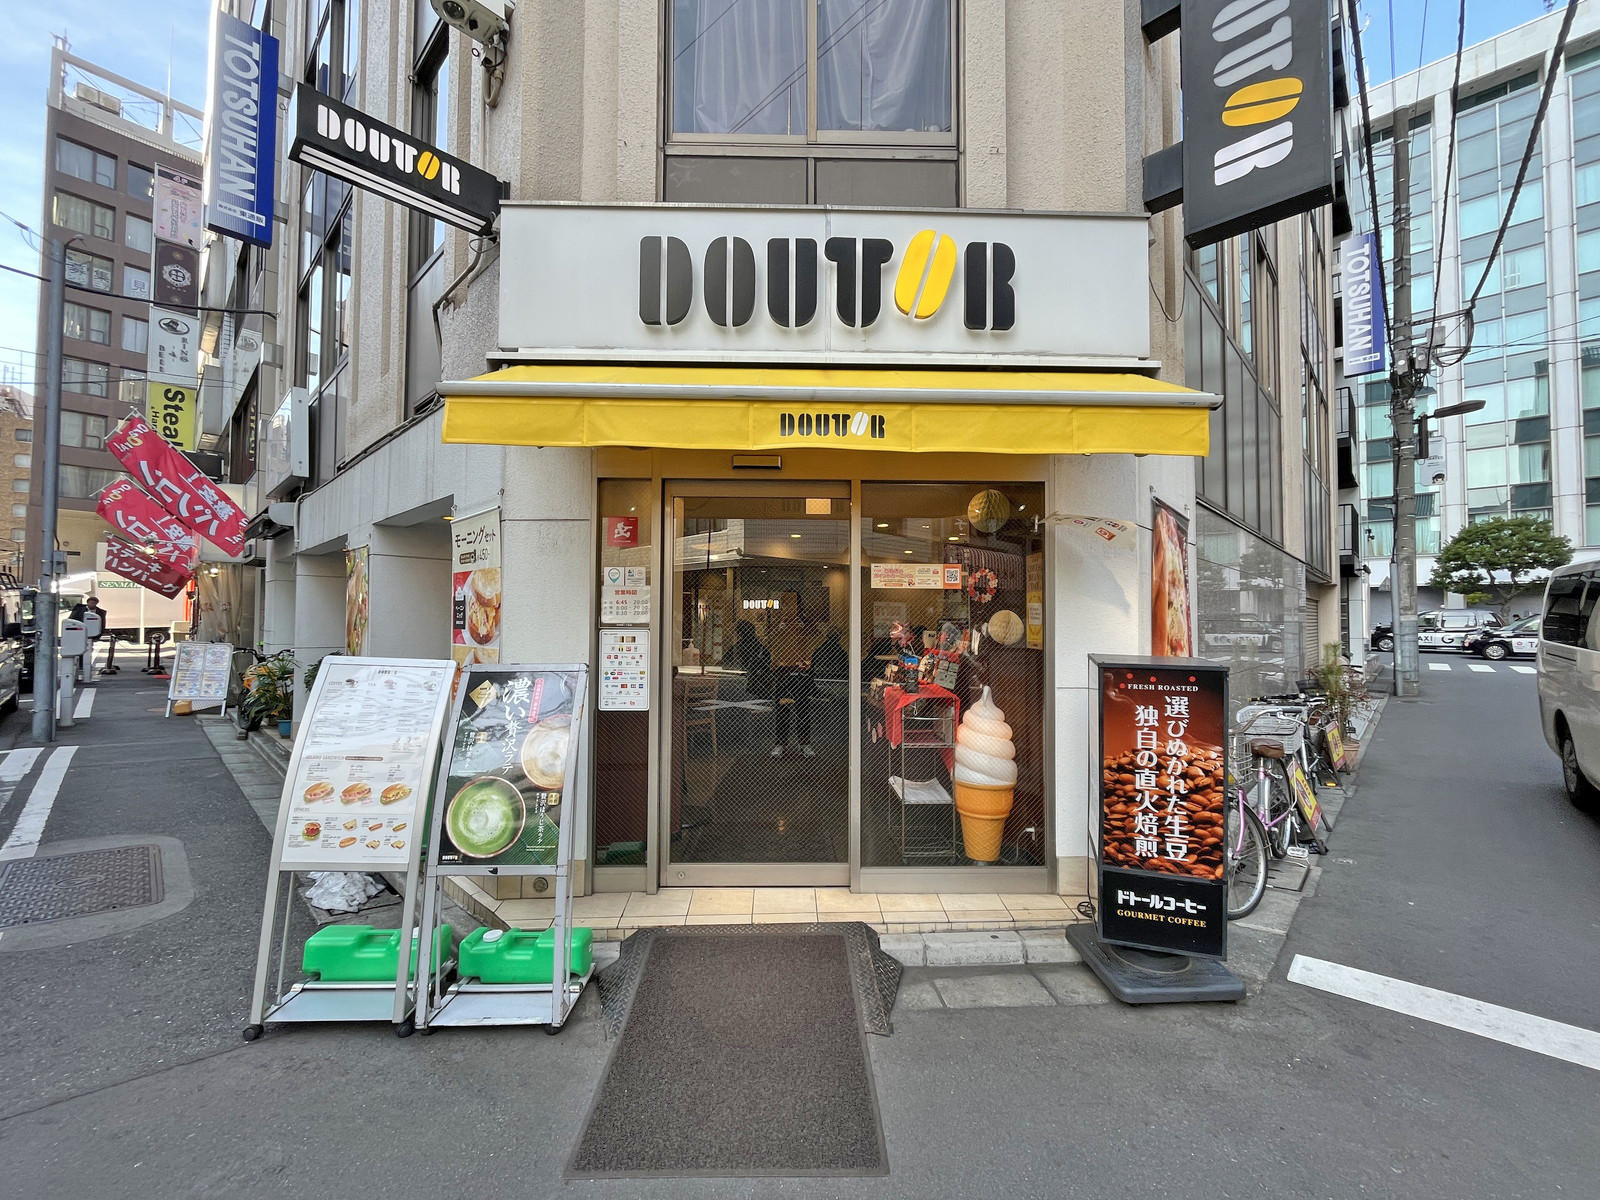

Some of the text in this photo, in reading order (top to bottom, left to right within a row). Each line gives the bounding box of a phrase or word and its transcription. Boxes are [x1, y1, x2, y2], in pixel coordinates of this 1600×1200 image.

[219, 33, 261, 202] TOTSUHAN
[316, 104, 460, 195] DOUTOR
[638, 229, 1017, 331] DOUTOR
[1347, 243, 1371, 350] TOTSUHAN
[780, 412, 886, 440] DOUTOR
[106, 555, 180, 593] ハンバーグ
[107, 542, 162, 573] ステーキ
[743, 600, 780, 610] DOUTOR
[1127, 683, 1199, 692] FRESH ROASTED
[502, 677, 533, 775] 濃い贅沢ラテ
[1134, 704, 1159, 858] 独自の直火焙煎
[1164, 695, 1190, 862] 選びぬかれた生豆
[1117, 889, 1207, 914] ドトールコーヒー
[1117, 908, 1207, 928] GOURMET COFFEE
